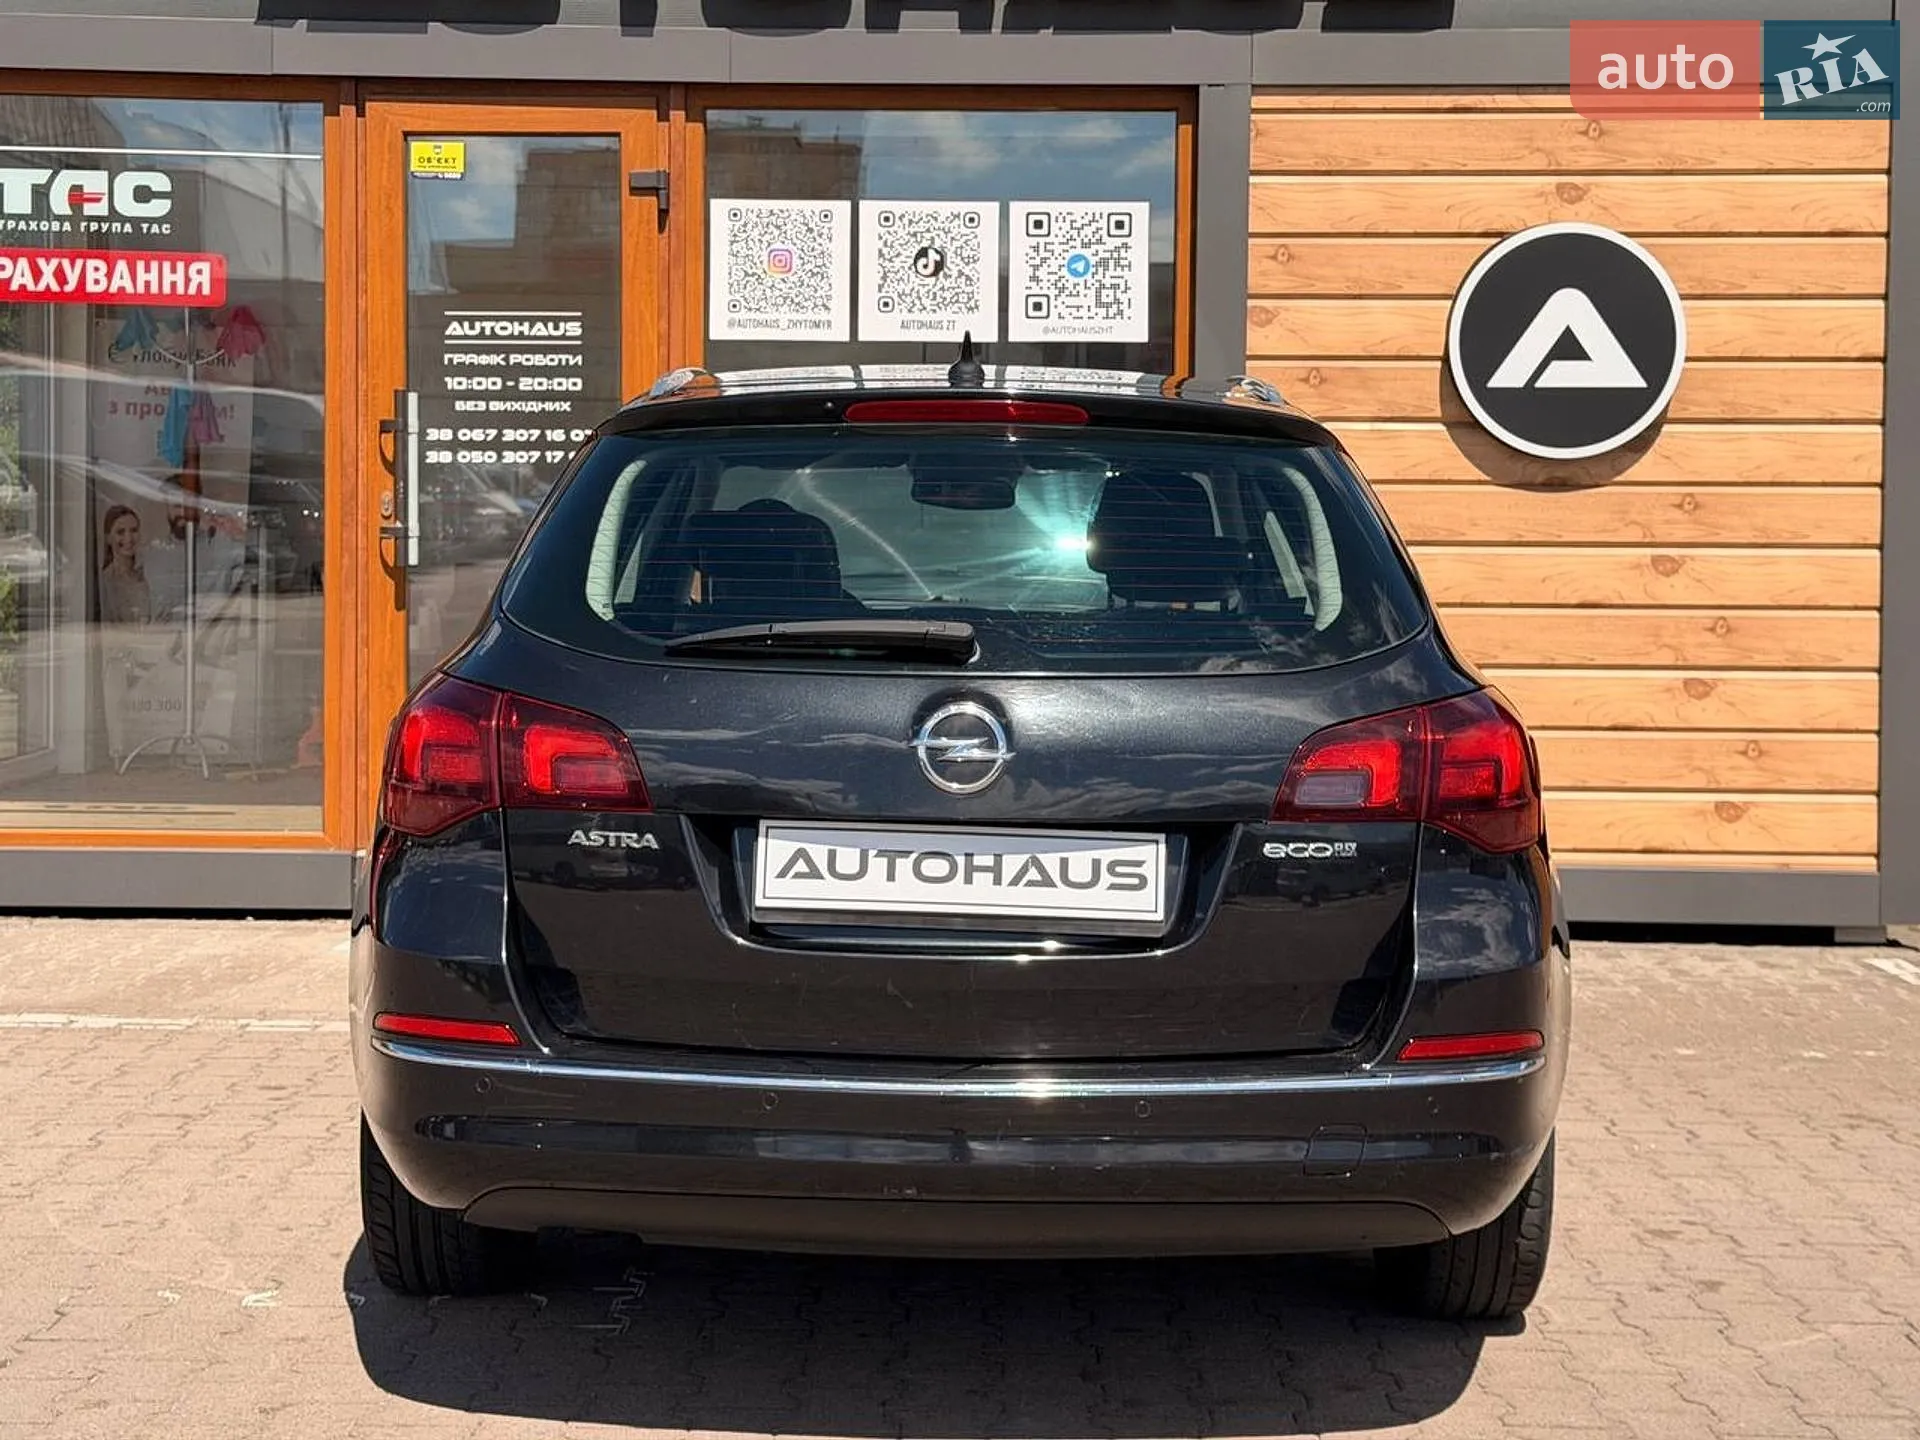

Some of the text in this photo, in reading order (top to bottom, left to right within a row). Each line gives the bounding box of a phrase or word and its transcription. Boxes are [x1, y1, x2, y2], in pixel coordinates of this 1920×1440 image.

[80, 221, 133, 233] ГРУПА
[140, 223, 172, 235] ТАС
[444, 321, 583, 337] AUTOHAUS
[900, 320, 944, 331] AUTOHAUS
[444, 354, 583, 367] ГРАФІК РОБОТИ
[444, 376, 502, 391] 10:00
[518, 376, 583, 392] 20:00
[455, 400, 572, 413] БЕЗ ВИХІДНИХ
[425, 428, 453, 442] 38
[457, 428, 499, 442] 067
[501, 428, 541, 442] 307
[545, 429, 567, 442] 16
[425, 450, 453, 464] 38
[456, 450, 498, 464] 050
[501, 450, 541, 464] 307
[544, 450, 567, 464] 17
[567, 829, 660, 850] ASTRA
[774, 846, 1149, 892] AUTOHAUS
